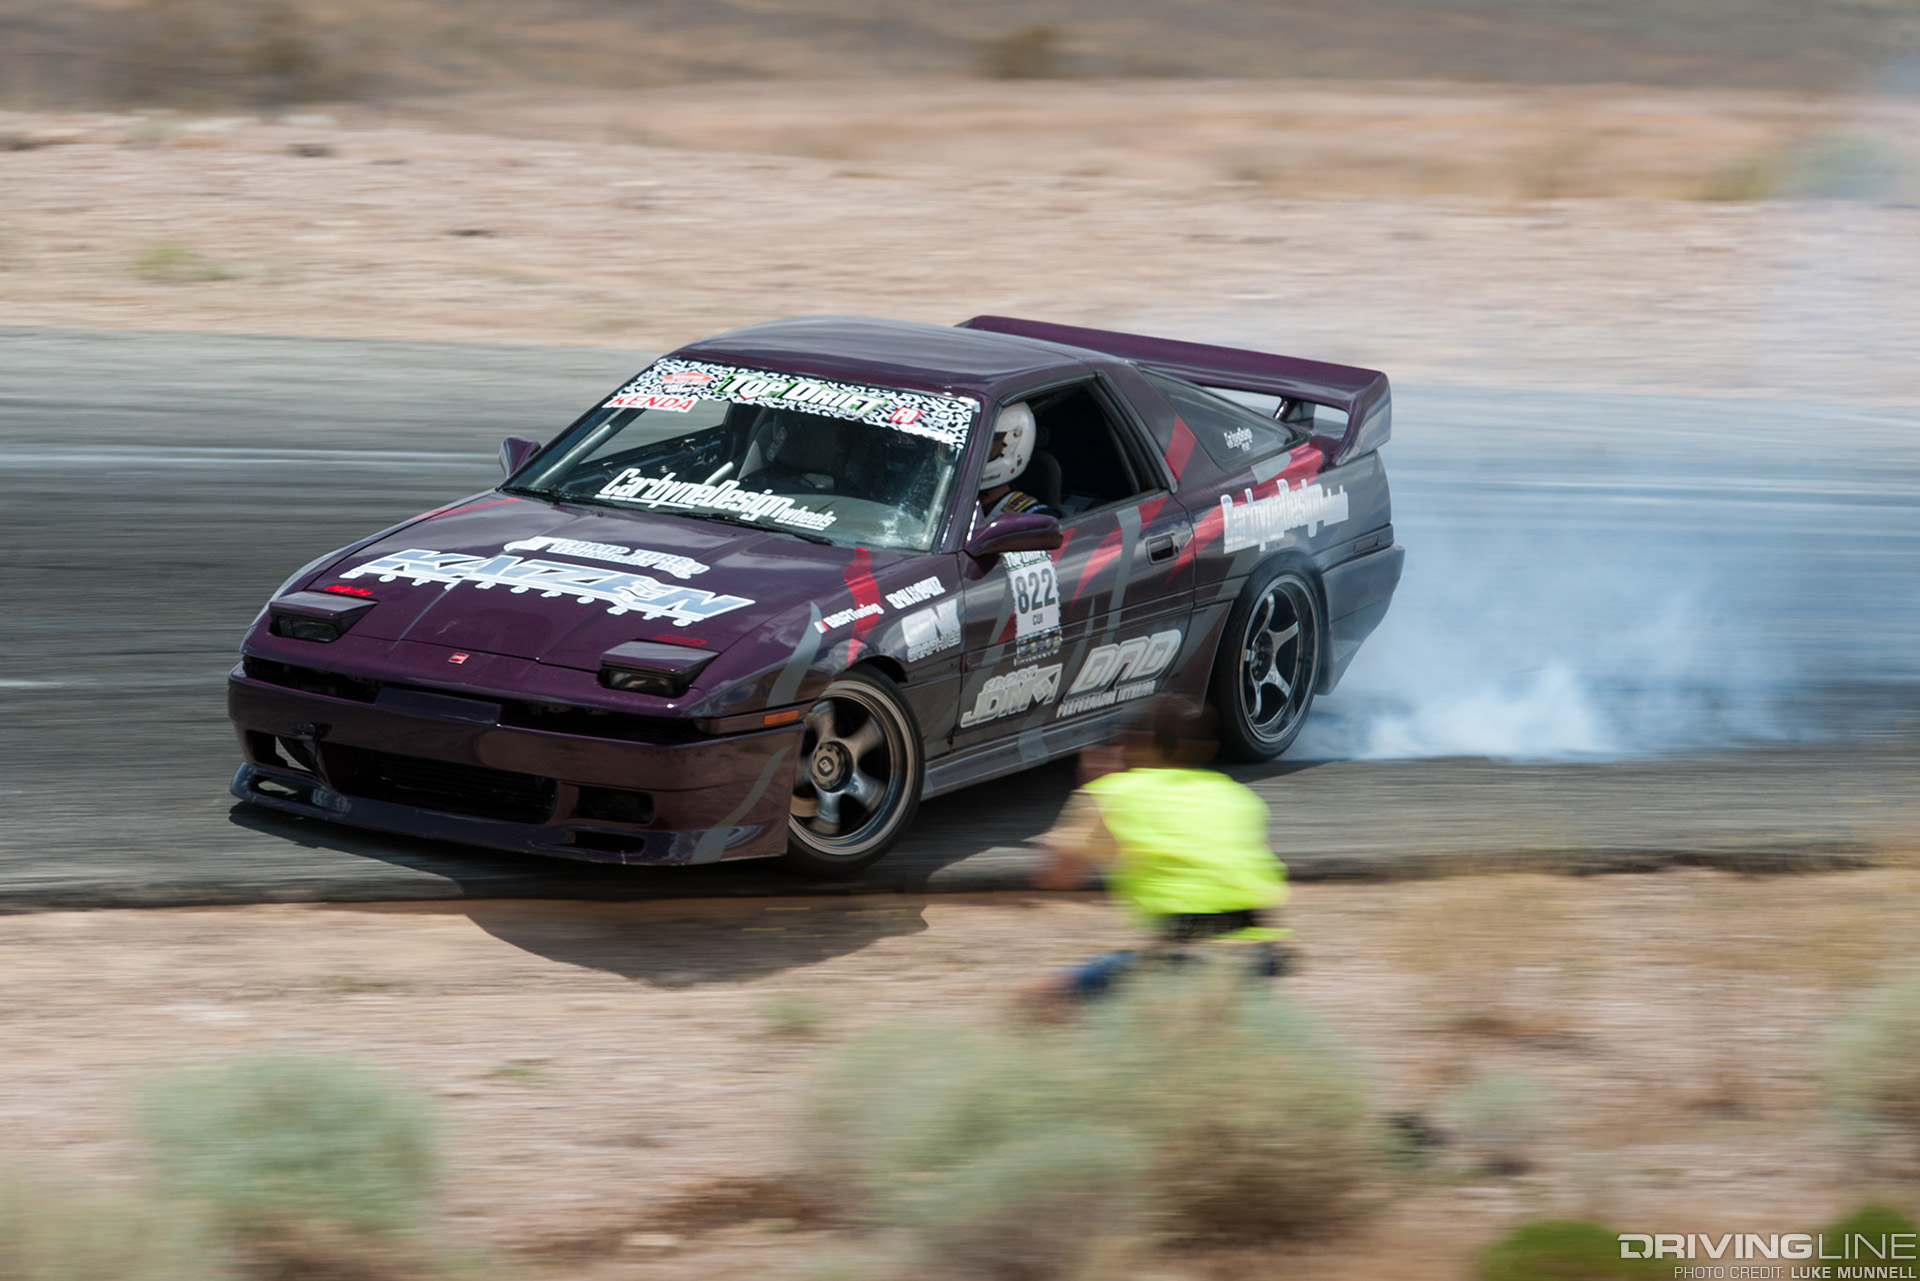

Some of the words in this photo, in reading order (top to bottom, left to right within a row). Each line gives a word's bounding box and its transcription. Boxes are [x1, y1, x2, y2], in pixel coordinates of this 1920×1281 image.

[608, 395, 694, 411] KENDA
[723, 375, 789, 398] TOP
[782, 382, 887, 412] DRIFT
[1014, 568, 1057, 615] 822
[1032, 612, 1044, 626] CUI
